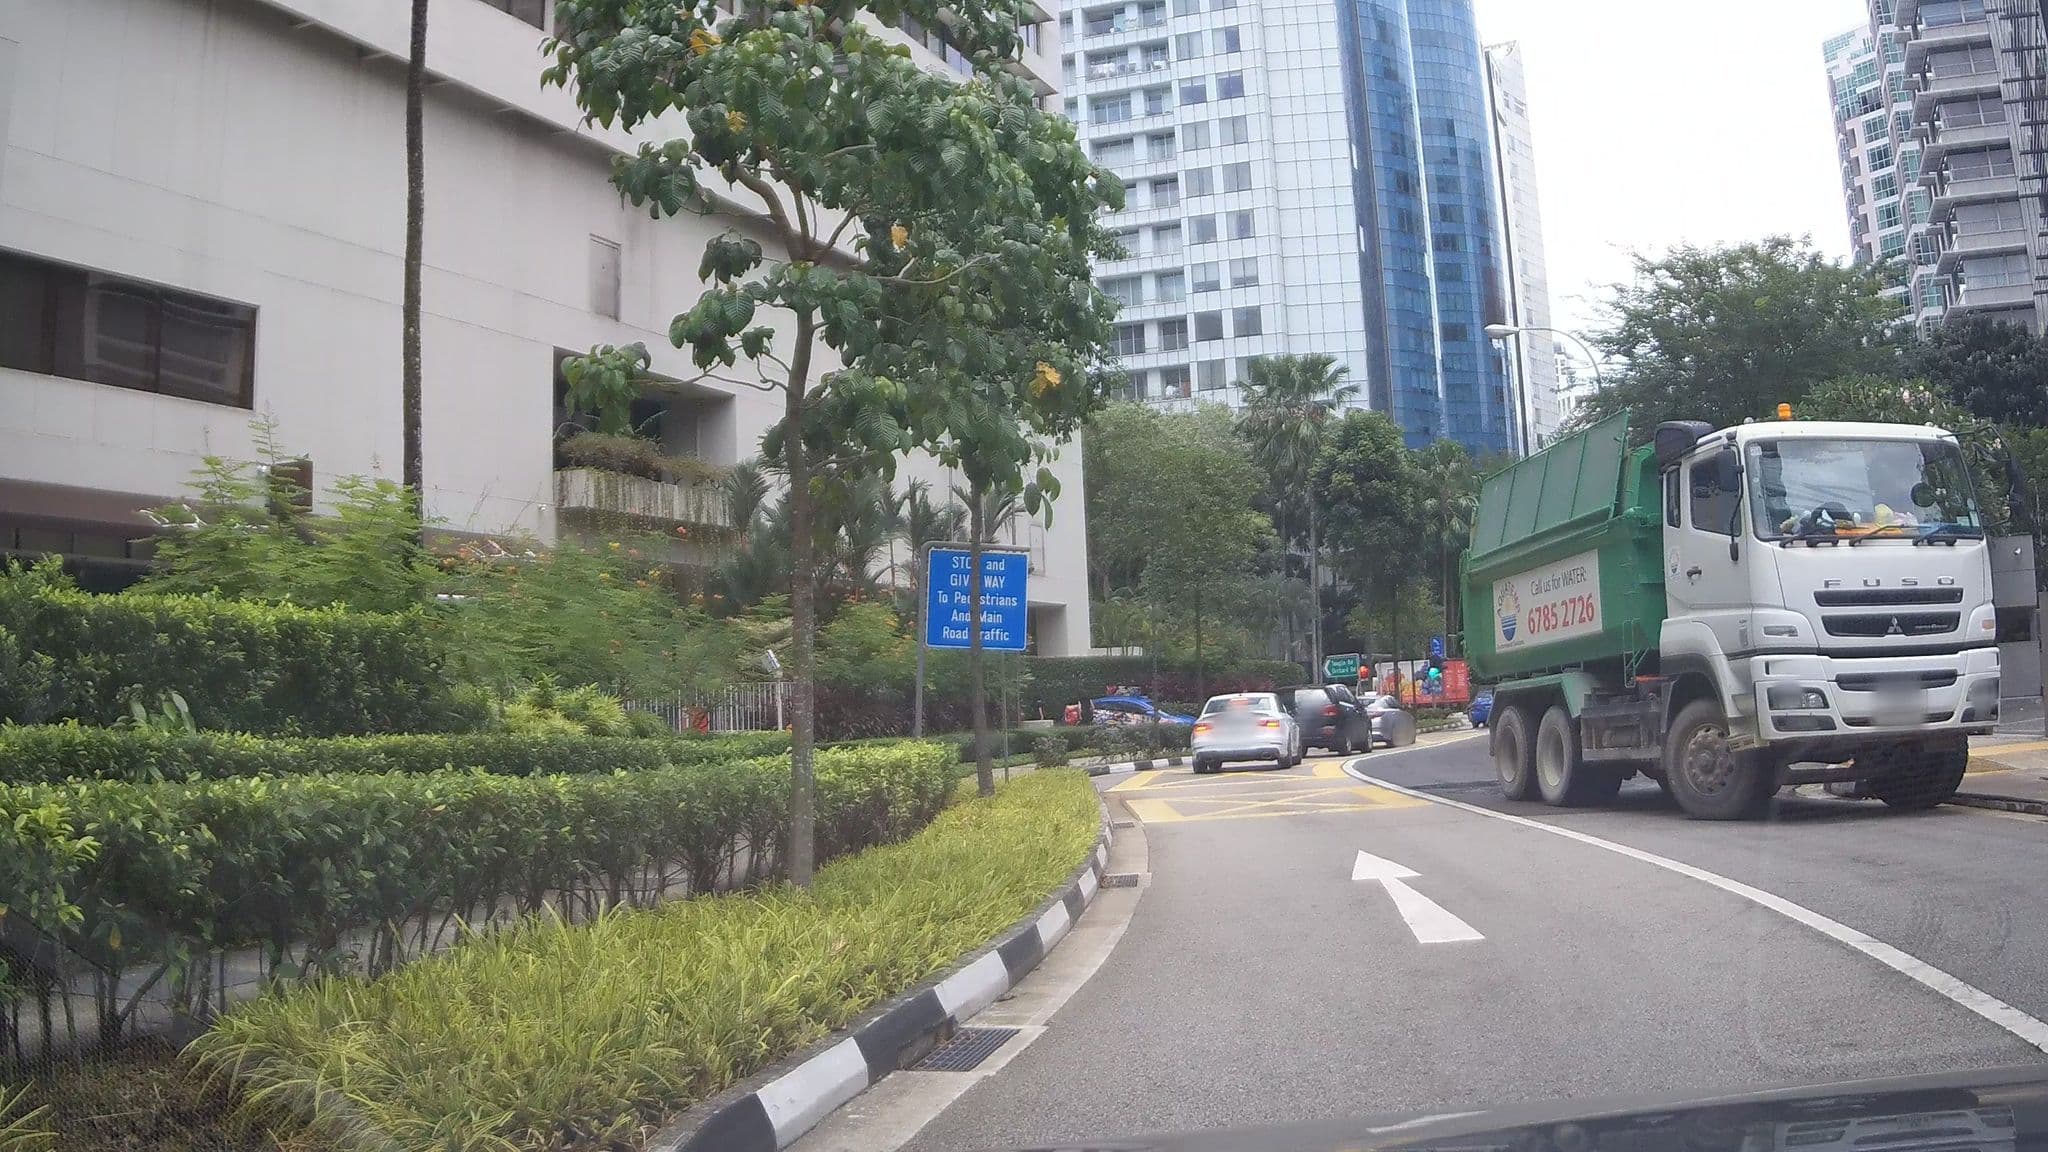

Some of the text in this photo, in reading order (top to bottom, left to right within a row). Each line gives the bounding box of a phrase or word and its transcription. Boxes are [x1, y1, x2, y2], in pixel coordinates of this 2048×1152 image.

[986, 559, 1005, 571] and
[950, 574, 1005, 588] GIV WAY
[1530, 566, 1586, 596] Call us for WATER
[1823, 575, 1955, 589] FUSO
[937, 590, 948, 603] To
[951, 609, 971, 622] And
[1528, 602, 1558, 634] 6785
[1560, 593, 1595, 627] 2726
[943, 626, 1009, 641] Road raffic
